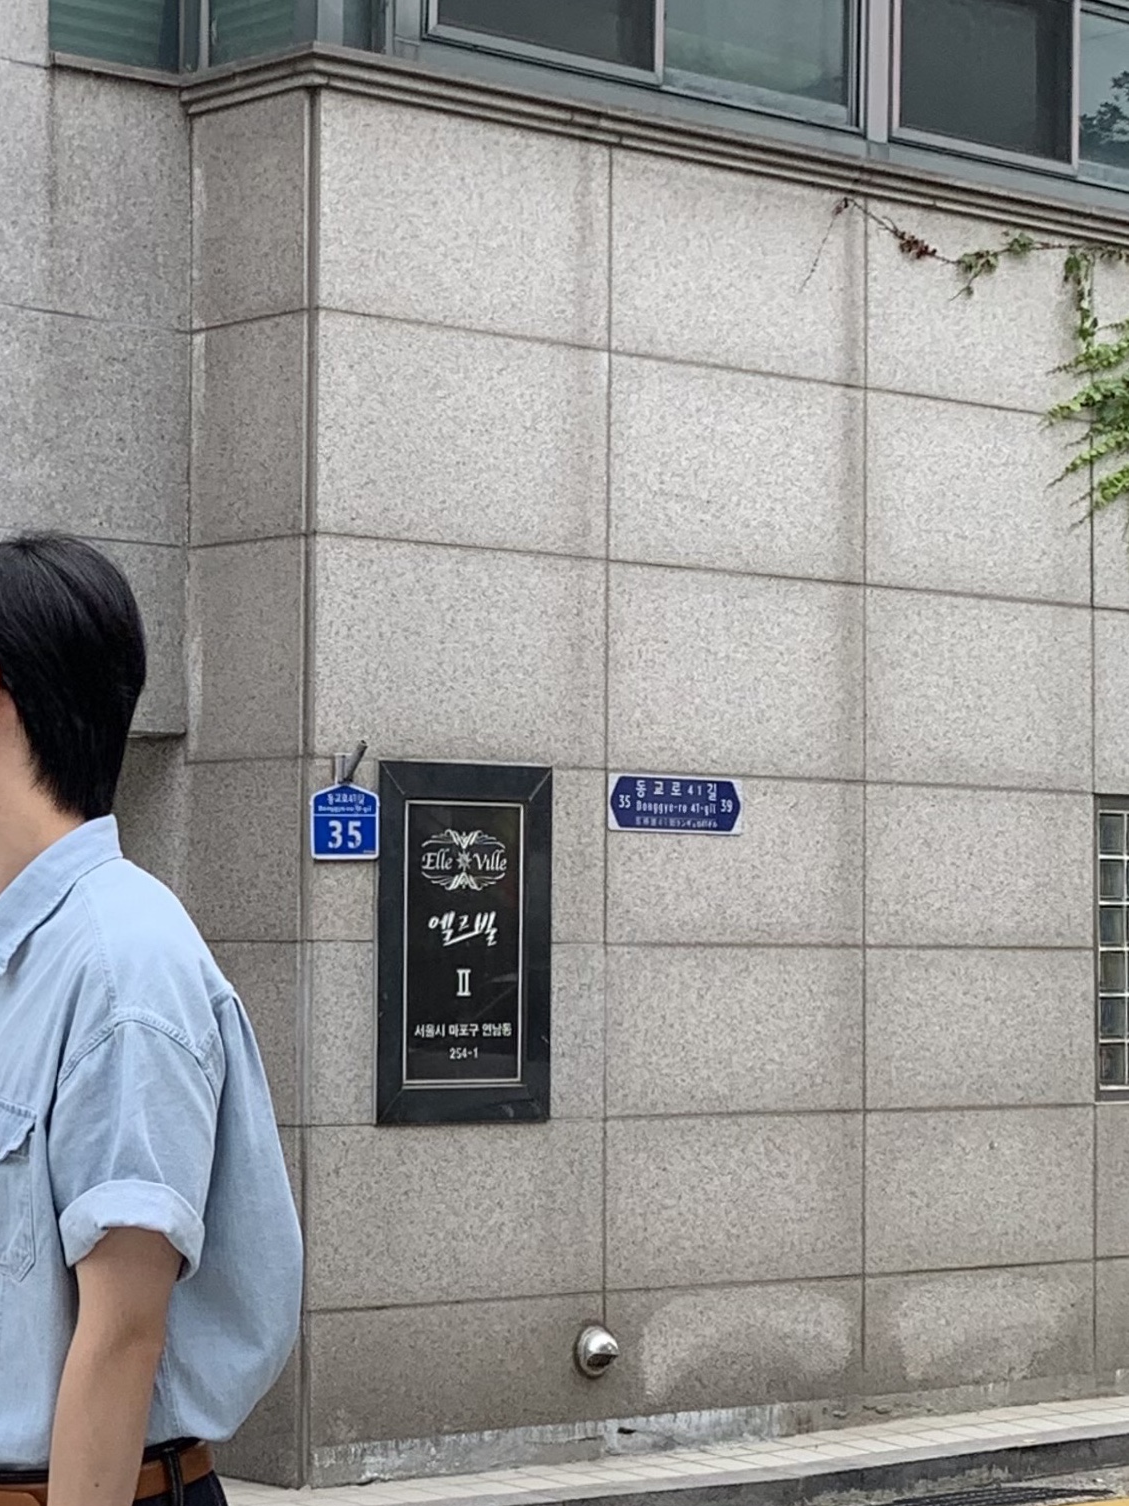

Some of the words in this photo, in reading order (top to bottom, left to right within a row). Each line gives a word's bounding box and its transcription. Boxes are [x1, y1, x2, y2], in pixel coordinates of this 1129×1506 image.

[618, 794, 631, 809] 35
[690, 802, 717, 816] 41-gil
[720, 799, 734, 813] 39
[328, 820, 362, 849] 35
[421, 848, 453, 870] Elle
[473, 849, 507, 871] Ville
[428, 911, 498, 947] 엘르빌
[414, 1023, 446, 1038] 서울시
[448, 1023, 479, 1038] 마포구
[482, 1022, 512, 1037] 연남동
[449, 1046, 478, 1060] 254-1
